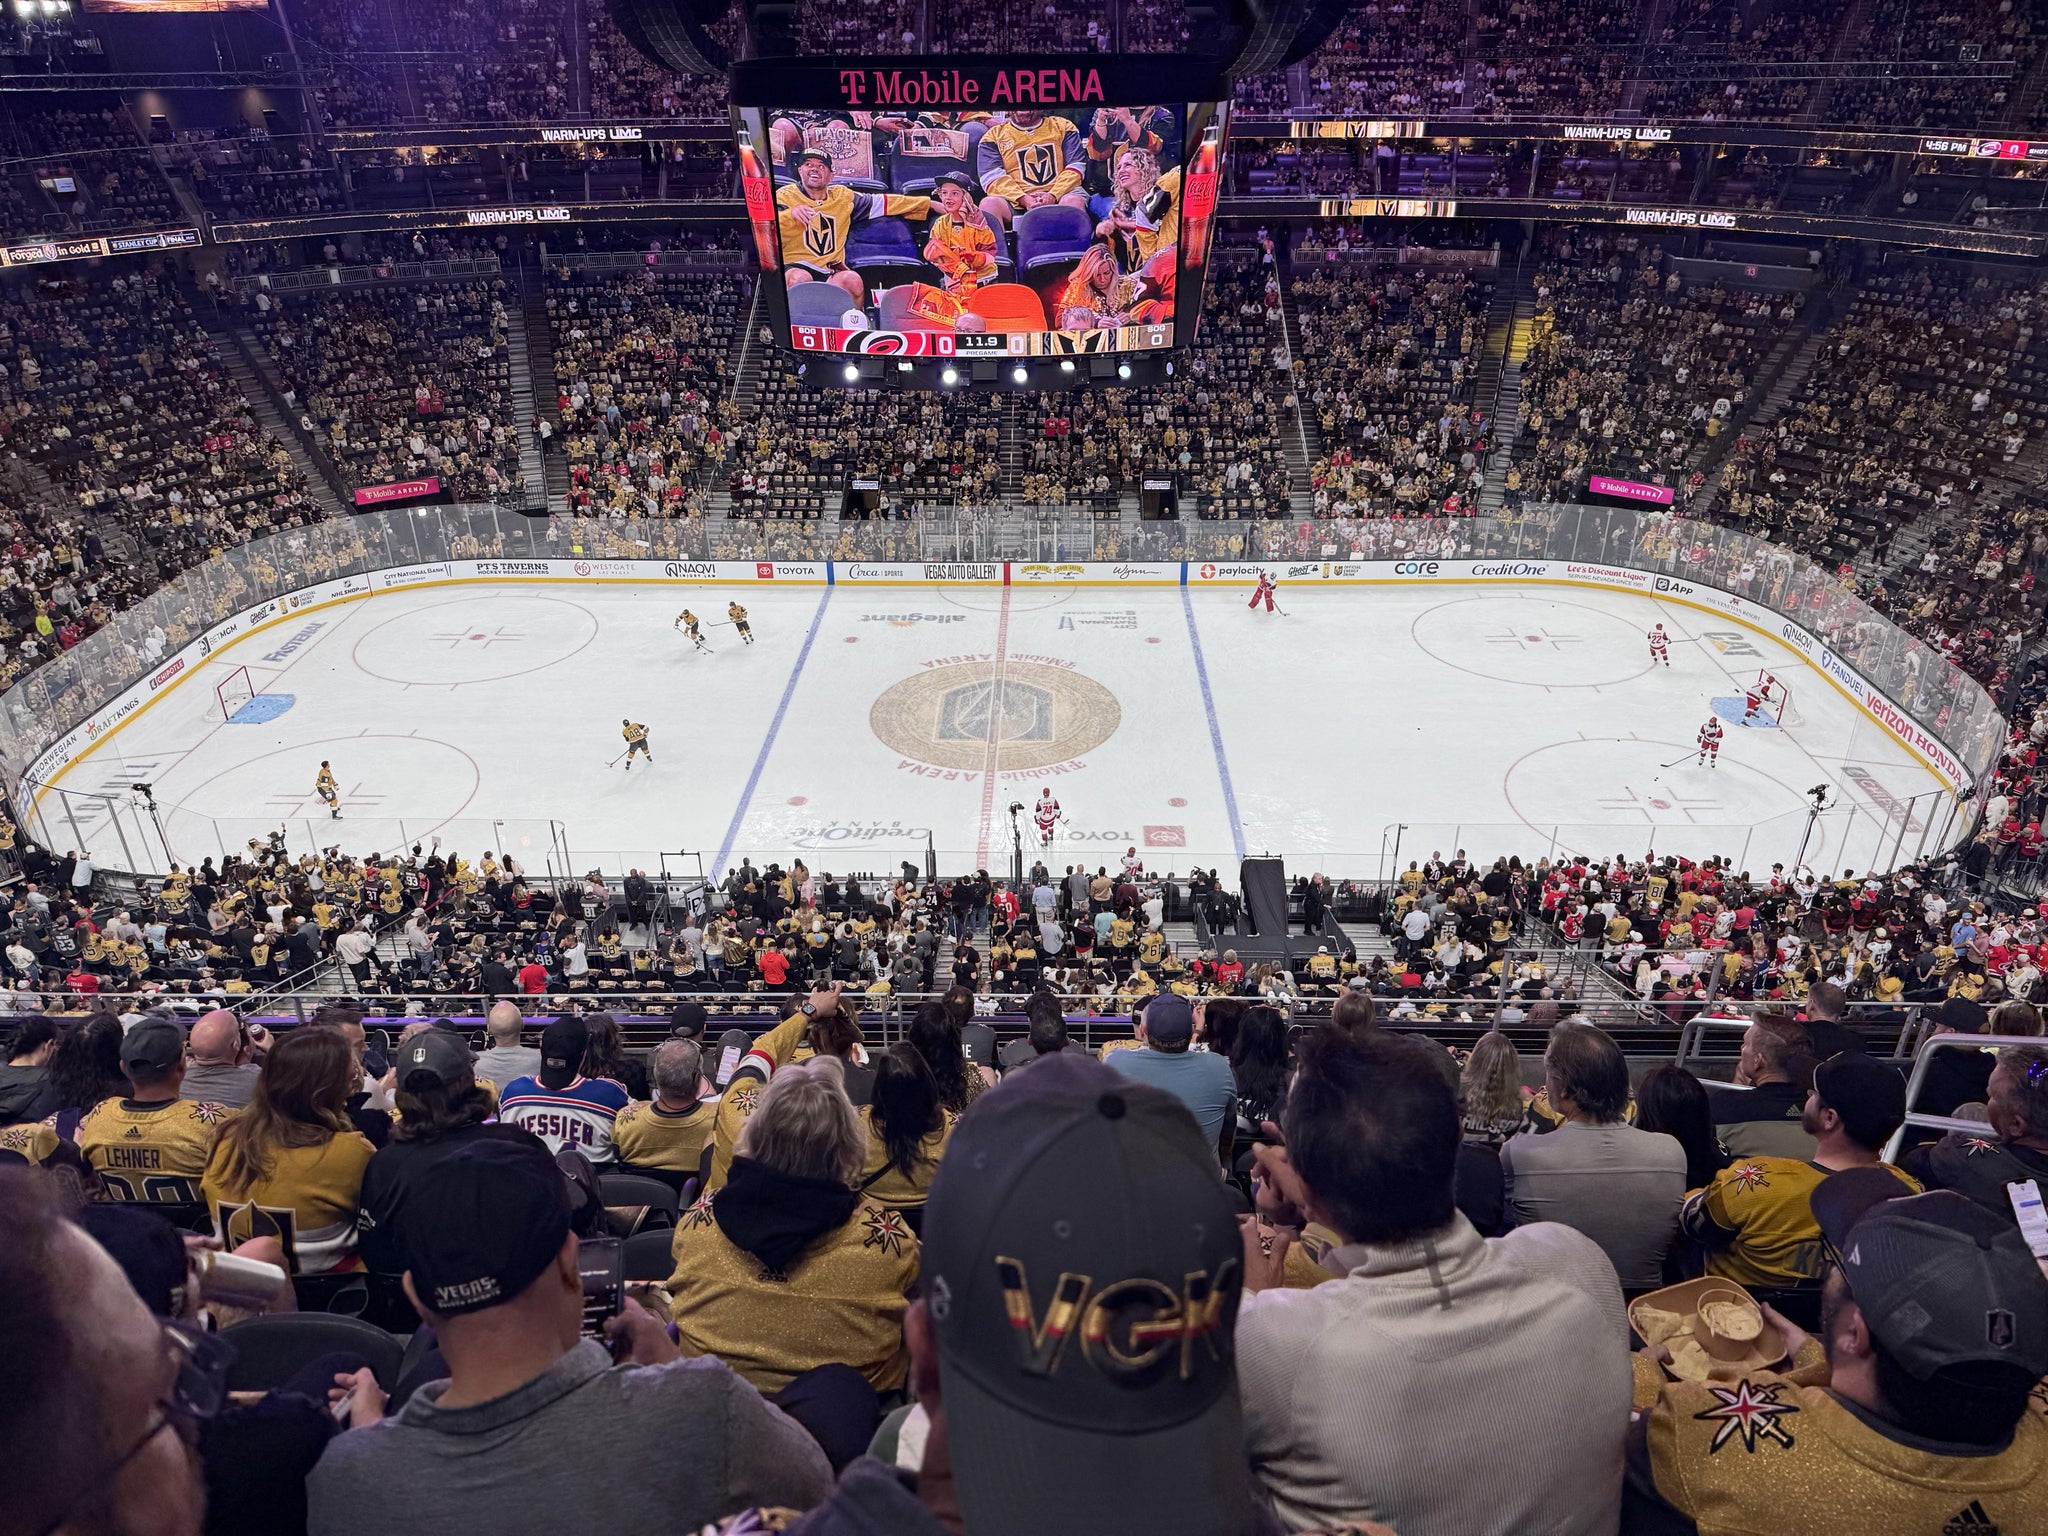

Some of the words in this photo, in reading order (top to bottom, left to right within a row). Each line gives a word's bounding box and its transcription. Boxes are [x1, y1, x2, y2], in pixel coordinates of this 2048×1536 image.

[991, 68, 1104, 103] ARENA
[541, 128, 607, 141] WARM-UPS
[610, 128, 643, 140] UMC
[1564, 126, 1632, 139] WARM-UPS
[1635, 128, 1672, 140] UMC
[1950, 142, 1967, 152] PM
[467, 210, 534, 223] WARM-UPS
[537, 209, 570, 220] UMC
[1626, 210, 1696, 225] WARM-UPS
[1700, 213, 1736, 227] UMC
[117, 239, 145, 248] STANLEY
[145, 238, 158, 246] CUP
[167, 236, 186, 245] FINAL
[10, 248, 44, 261] Forged
[58, 246, 68, 256] in
[69, 243, 91, 255] Gold
[803, 336, 815, 348] 0
[938, 336, 953, 354] 0
[966, 336, 998, 347] 11.9
[1010, 335, 1025, 354] 0
[1151, 334, 1163, 345] 0
[397, 486, 424, 495] ARENA
[1630, 488, 1657, 498] ARENA
[397, 570, 427, 578] NATIONAL
[427, 567, 445, 575] BANK
[500, 563, 549, 571] TAVERNS
[592, 563, 635, 571] WESTGATE
[678, 563, 716, 574] NAQVI
[777, 567, 815, 575] TOYOTA
[849, 564, 880, 580] Circa
[924, 564, 946, 580] VEGAS
[947, 564, 965, 580] AUTO
[966, 564, 997, 580] GALLERY
[1219, 566, 1265, 577] paylocity
[1395, 562, 1440, 574] core
[1472, 563, 1546, 576] CreditOne
[1567, 565, 1587, 573] Lee's
[1588, 567, 1622, 578] Discount
[1623, 571, 1648, 582] Liquor
[1592, 575, 1616, 583] NEVADA
[857, 613, 966, 624] allegiant
[262, 621, 329, 662] FASTENAL
[1652, 635, 1662, 643] 22
[1791, 628, 1812, 650] NAQVI
[920, 653, 993, 668] ARENA
[157, 659, 184, 685] CHIPOTLE
[1831, 661, 1864, 697] FANDUEL
[90, 697, 140, 741] DRAFTKINGS
[1867, 692, 1913, 742] verizon
[35, 735, 77, 774] NORWEGIAN
[1915, 732, 1962, 787] HONDA
[897, 760, 978, 782] ARENA
[1043, 806, 1052, 815] 74
[406, 876, 419, 888] 93
[1652, 887, 1663, 898] 81
[926, 896, 937, 905] 24
[584, 907, 596, 918] 81
[467, 972, 483, 991] 27
[2020, 981, 2030, 993] 6
[105, 1147, 161, 1169] LEHNER
[437, 1276, 492, 1302] VEGAS
[995, 1255, 1237, 1379] VGK
